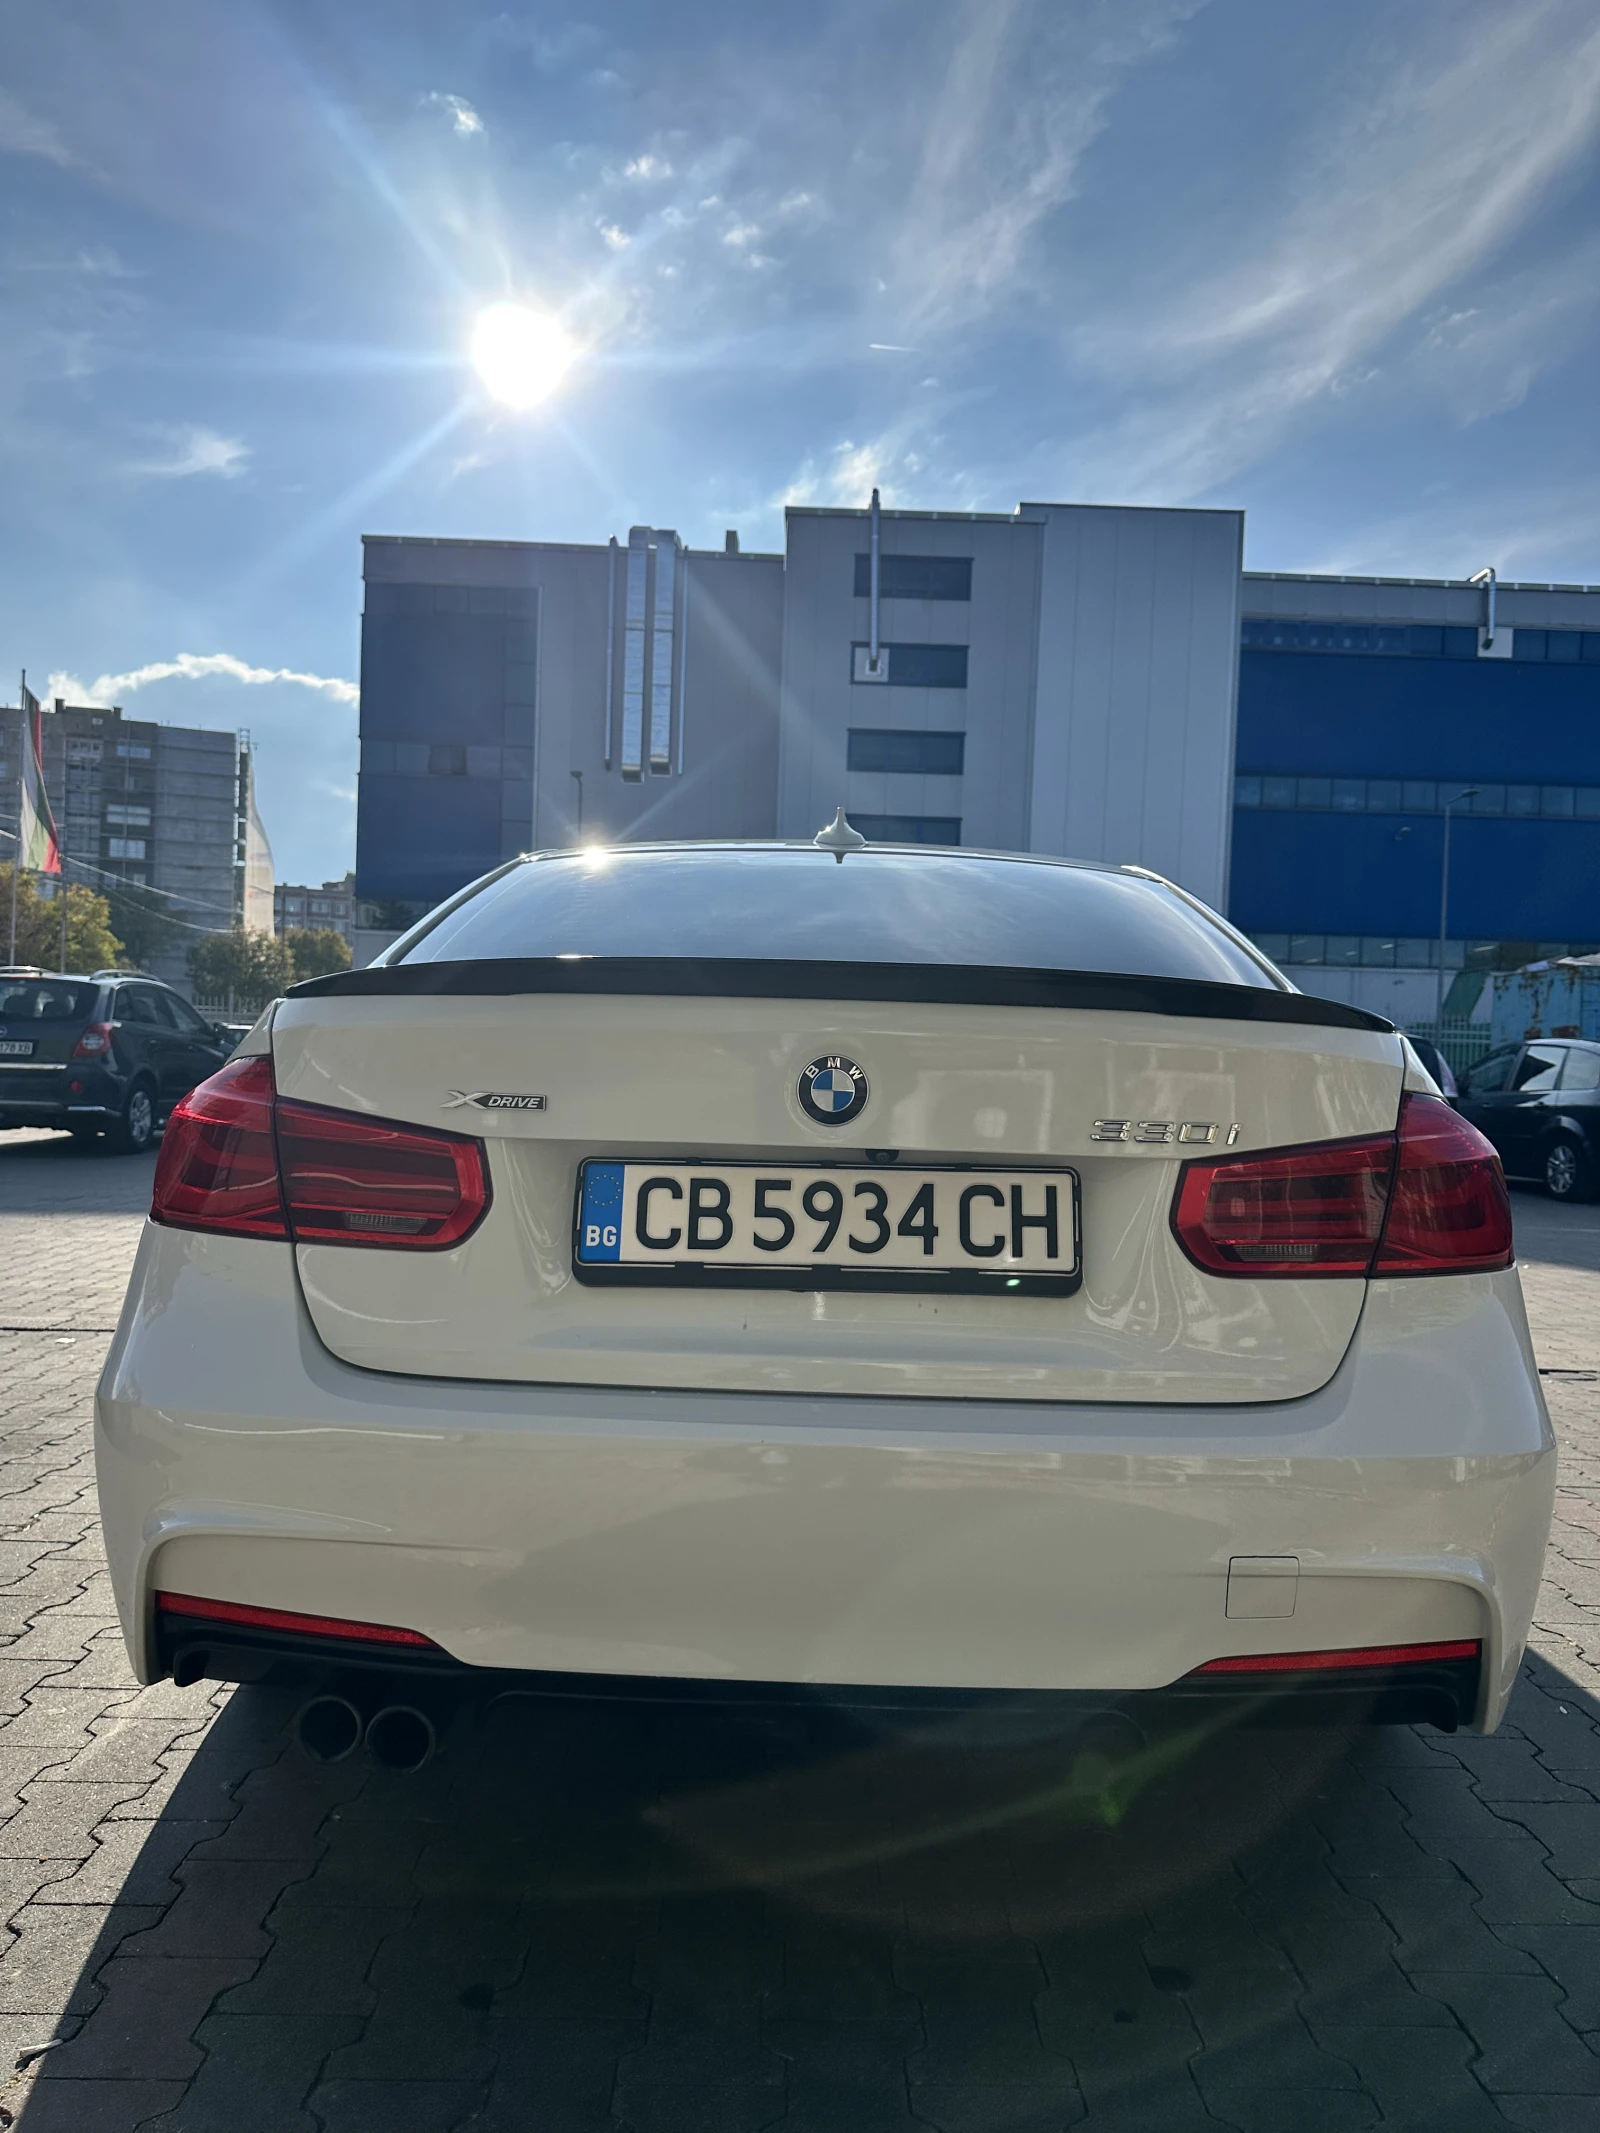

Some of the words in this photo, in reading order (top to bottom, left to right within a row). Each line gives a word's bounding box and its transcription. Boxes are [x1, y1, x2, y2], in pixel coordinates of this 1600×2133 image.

[805, 1057, 863, 1080] BMW
[1090, 1120, 1241, 1145] 330i
[636, 1177, 733, 1250] CB
[753, 1179, 939, 1255] 5934
[959, 1184, 1059, 1259] CH
[586, 1225, 617, 1247] BG
